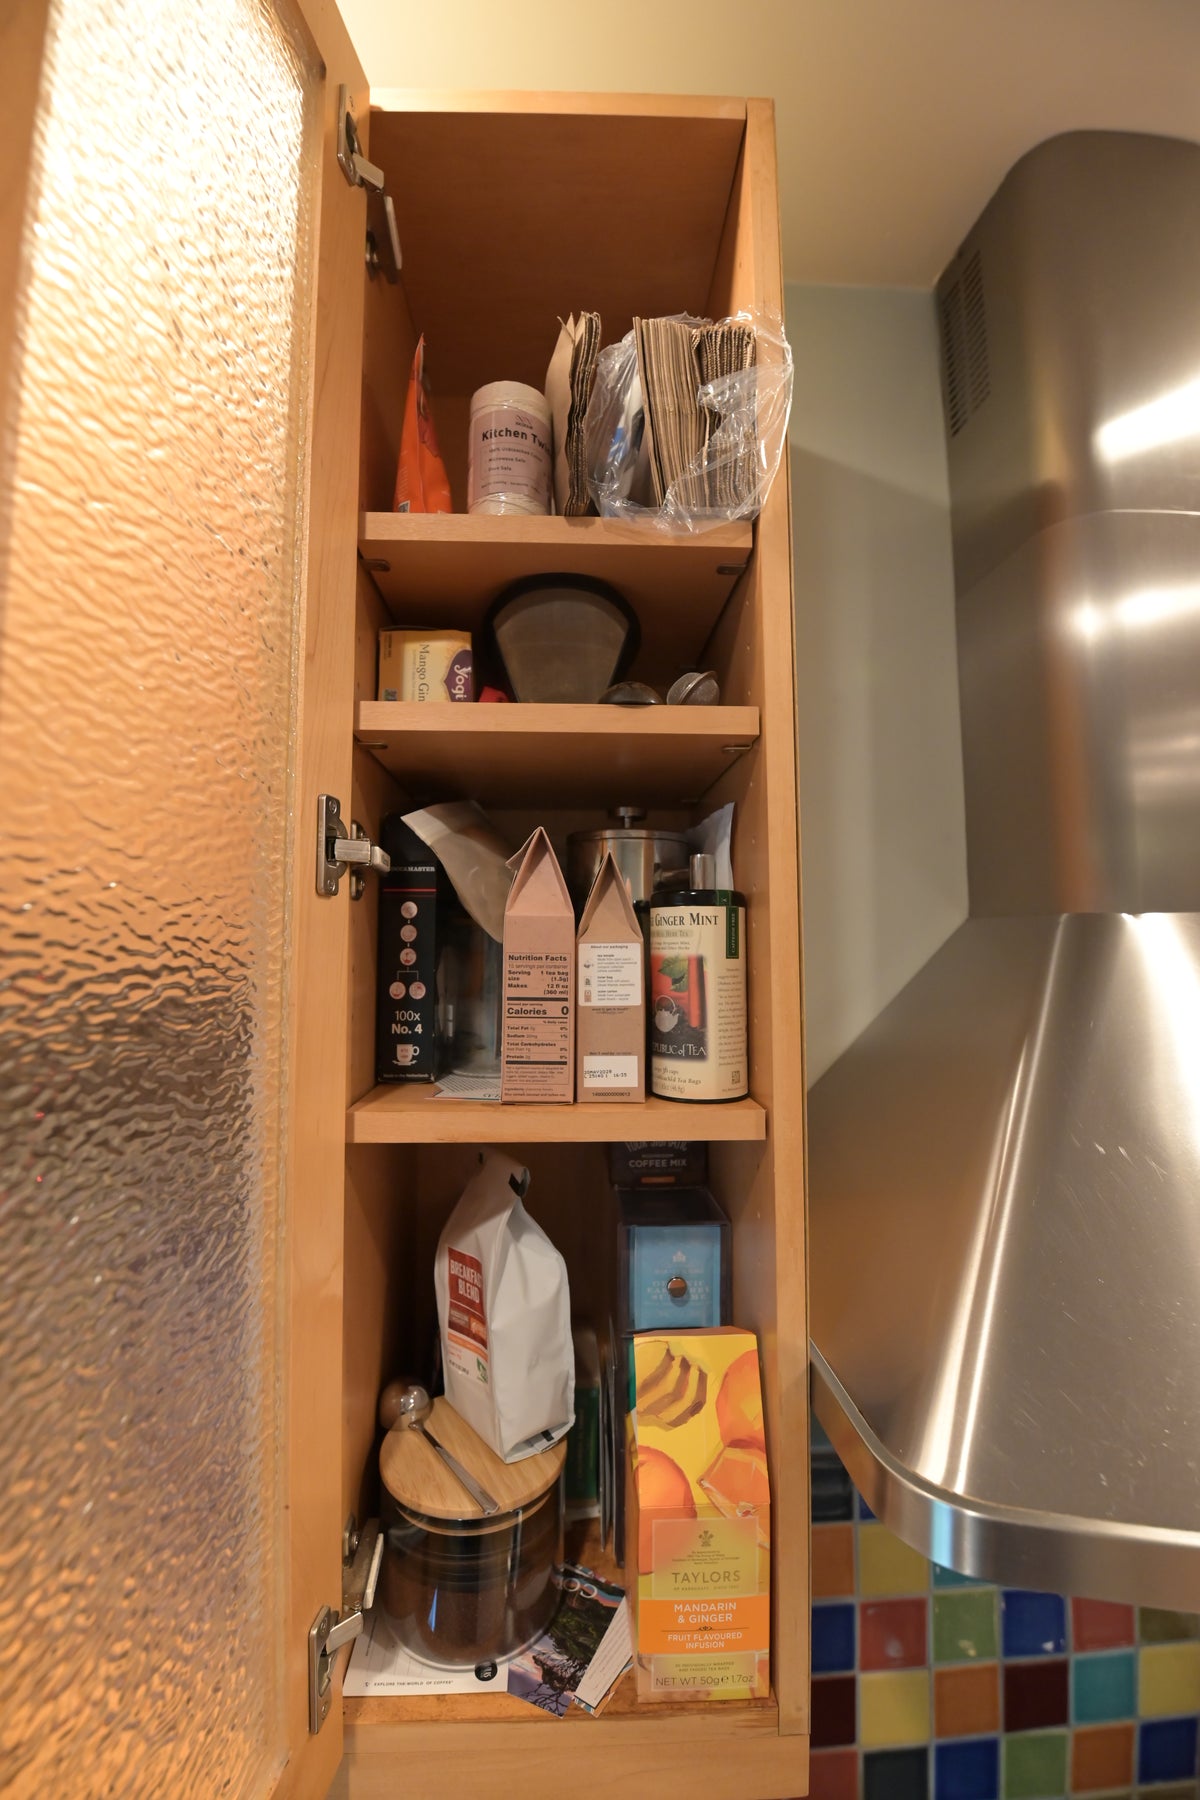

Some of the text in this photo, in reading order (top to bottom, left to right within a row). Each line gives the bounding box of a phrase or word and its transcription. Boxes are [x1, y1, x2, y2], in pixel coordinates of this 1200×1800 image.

[481, 427, 528, 441] Kitchen
[416, 643, 430, 680] Mango
[655, 913, 685, 927] GINGER
[689, 912, 719, 926] MINT
[395, 1010, 420, 1021] 100x
[507, 1005, 570, 1015] Calories 0
[392, 1023, 423, 1034] No. 4
[686, 1043, 706, 1056] TEA
[629, 1158, 688, 1168] COFFEE MIX
[458, 1278, 480, 1304] BLEND
[672, 1570, 741, 1583] TAYLORS
[674, 1602, 737, 1613] MANDARIN
[677, 1613, 733, 1623] & GINGER
[693, 1632, 743, 1641] FLAVOURED
[685, 1641, 725, 1649] INFUSION
[655, 1677, 679, 1686] NET
[680, 1677, 697, 1685] WT
[699, 1676, 720, 1686] 50g
[731, 1674, 754, 1683] 1.7oz
